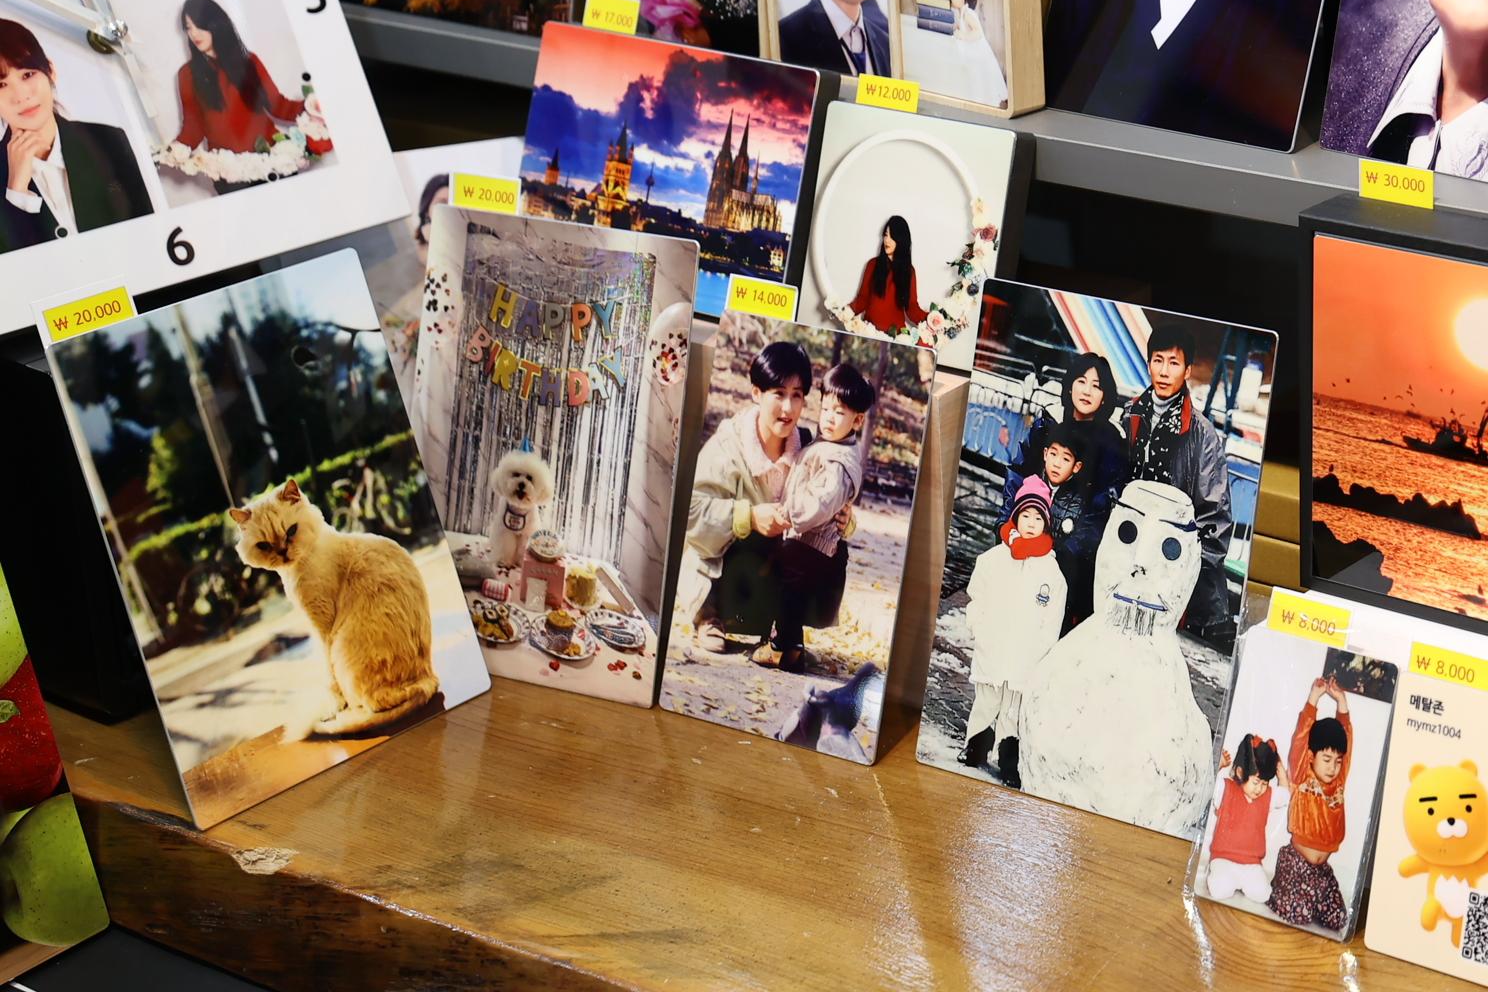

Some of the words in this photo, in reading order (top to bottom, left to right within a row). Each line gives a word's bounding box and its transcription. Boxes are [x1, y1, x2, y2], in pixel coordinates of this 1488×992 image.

[166, 226, 195, 266] 6
[488, 282, 617, 341] HAPPY
[466, 324, 626, 407] BIRTHDAY
[1409, 694, 1445, 716] 메탈존
[1406, 718, 1461, 740] mymz1004
